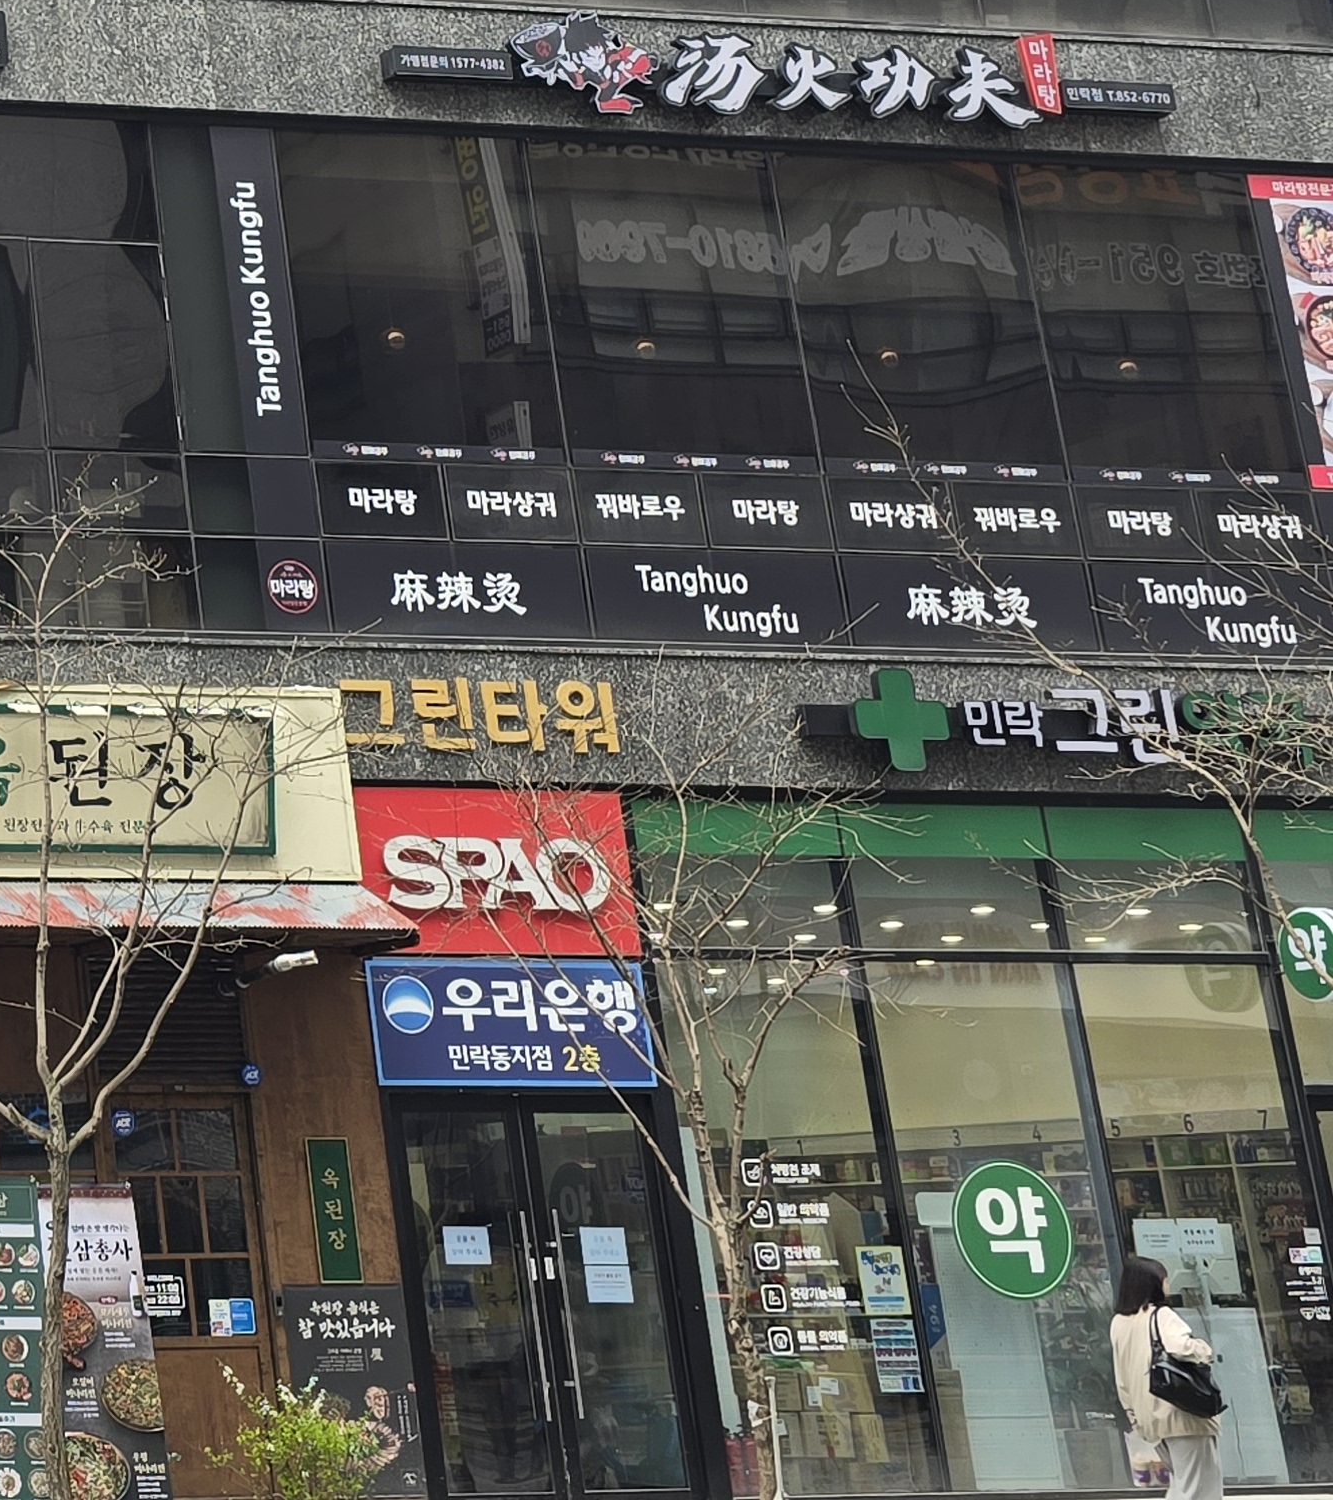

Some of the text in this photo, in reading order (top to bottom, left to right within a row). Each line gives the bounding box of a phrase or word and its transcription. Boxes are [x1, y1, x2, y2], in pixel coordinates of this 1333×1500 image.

[1027, 39, 1057, 108] 마라탕
[229, 181, 283, 417] Tanghuo Kungfu
[348, 487, 417, 518] 마라탕
[467, 490, 558, 520] 마라샹궈
[595, 493, 685, 522] 꿔바로우
[730, 498, 800, 527] 마라탕
[849, 503, 939, 530] 마라샹궈
[973, 506, 1061, 534] 꿔바로우
[1107, 509, 1173, 536] 마라탕
[635, 563, 749, 600] Tanghuo
[1137, 577, 1247, 610] Tanghuo
[704, 604, 800, 639] Kungfu
[1205, 616, 1298, 649] Kungfu
[339, 677, 622, 755] 그린타워
[963, 698, 1045, 750] 민락
[382, 835, 611, 912] SPAO
[441, 977, 640, 1034] 우리은행
[447, 1044, 601, 1073] 민락동지점 2층
[318, 1164, 349, 1252] 옥된장
[974, 1186, 1048, 1274] 약
[72, 1237, 134, 1262] 삼총사
[297, 1319, 315, 1340] 참
